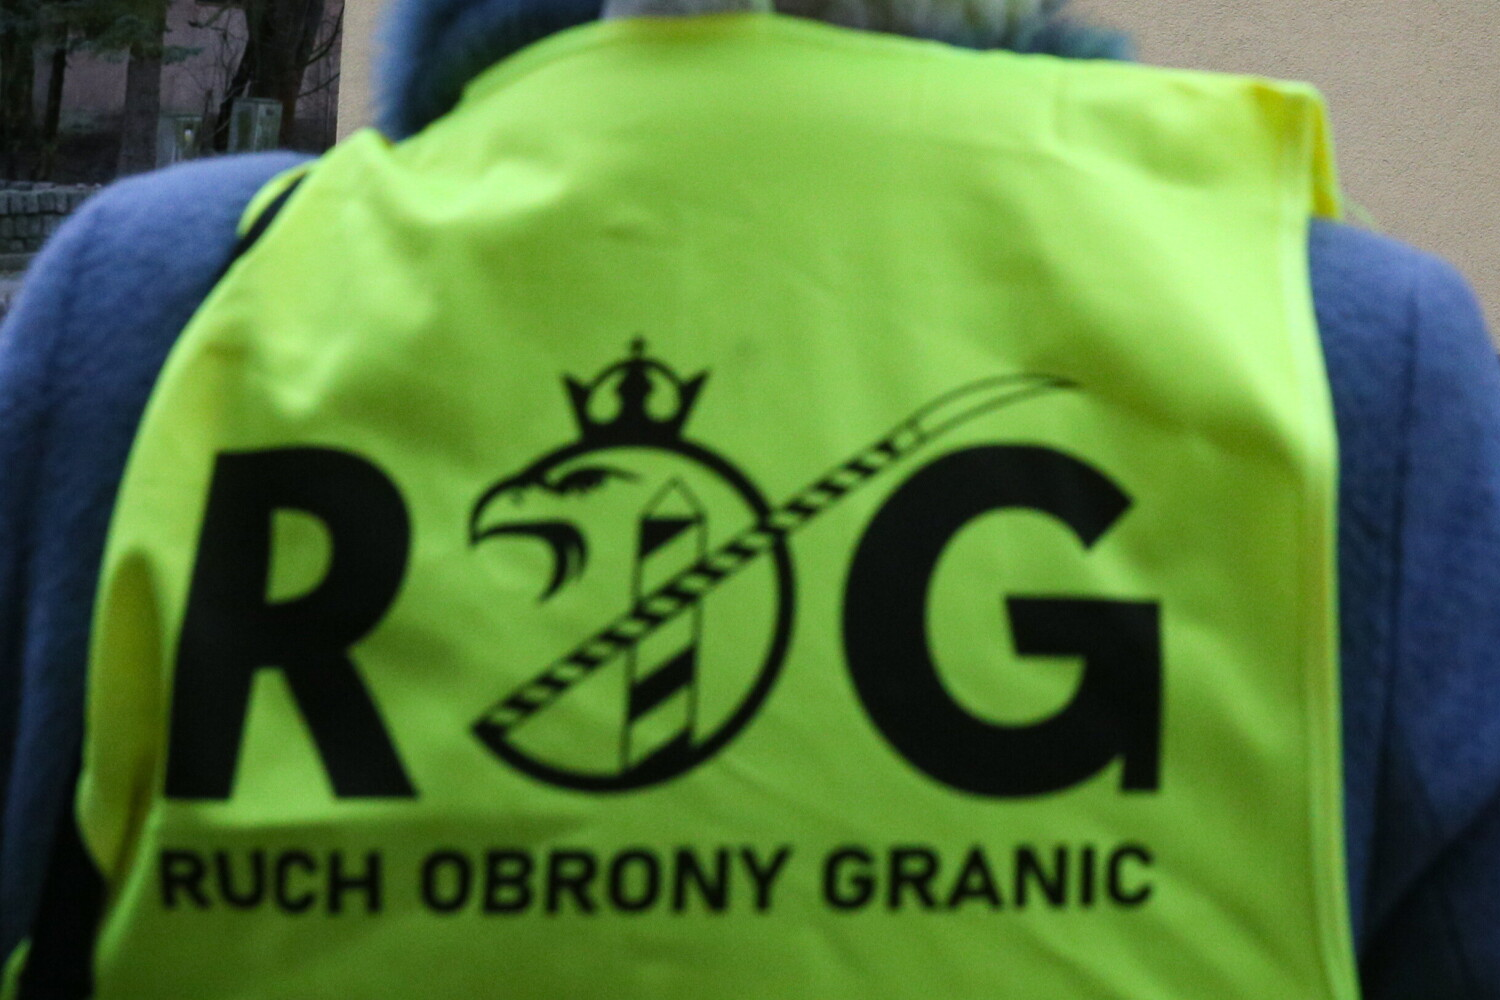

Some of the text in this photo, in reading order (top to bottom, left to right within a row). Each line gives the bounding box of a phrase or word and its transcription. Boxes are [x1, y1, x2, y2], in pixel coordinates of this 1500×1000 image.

[157, 845, 1154, 917] RUCH OBRONY GRANIC
